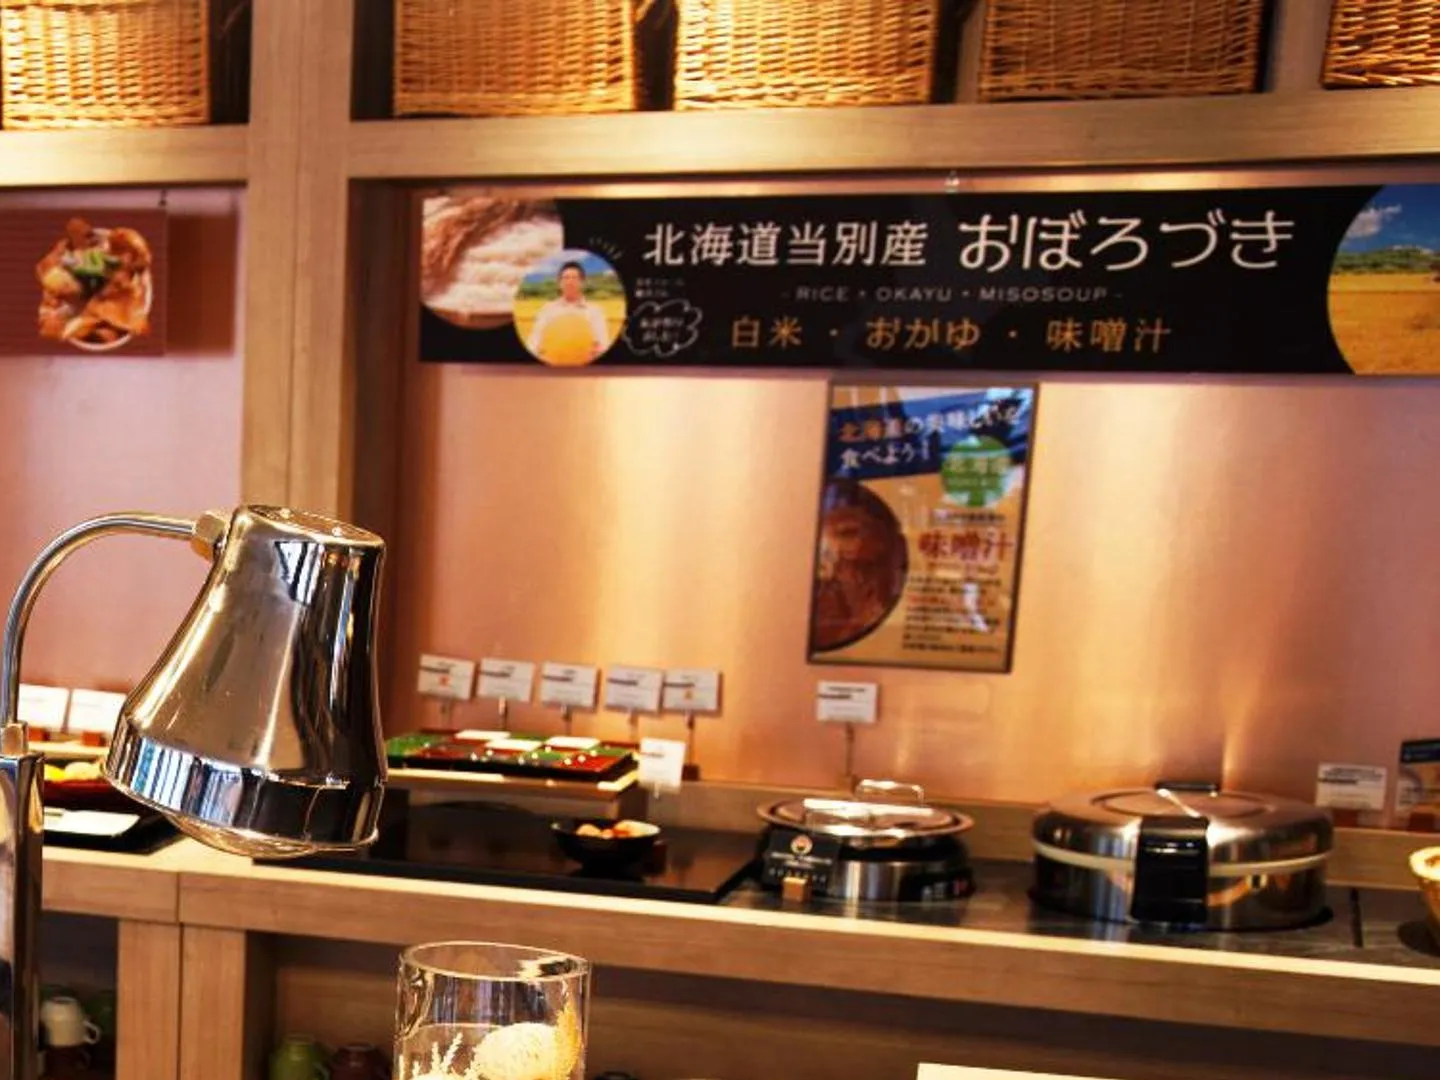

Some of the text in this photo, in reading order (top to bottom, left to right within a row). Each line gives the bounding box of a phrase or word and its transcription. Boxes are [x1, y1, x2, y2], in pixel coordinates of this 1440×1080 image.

[643, 220, 929, 267] 北海道当別産
[958, 208, 1295, 273] おぼろづき
[796, 286, 1109, 302] RICE OKAYU MISOSOUP
[730, 315, 803, 349] 白米
[1046, 316, 1172, 353] 味噌汁
